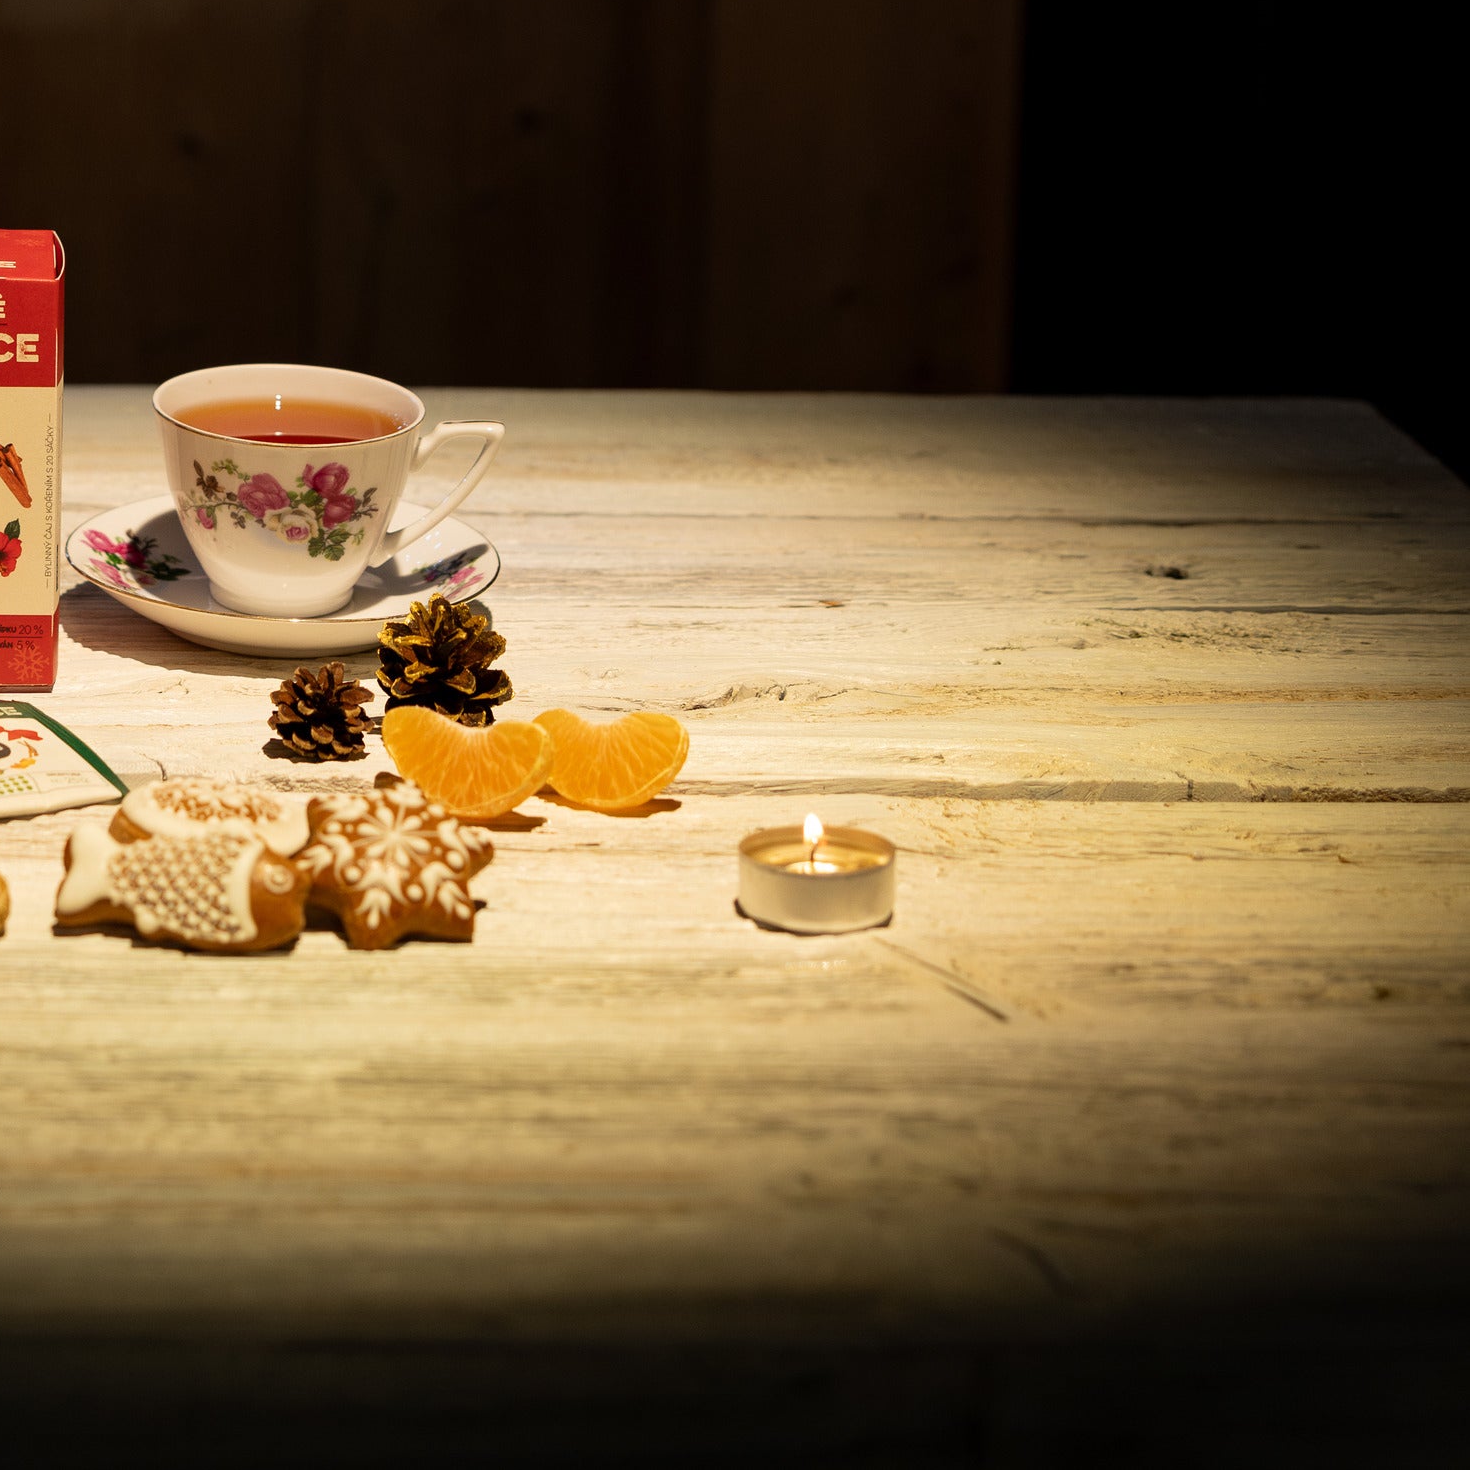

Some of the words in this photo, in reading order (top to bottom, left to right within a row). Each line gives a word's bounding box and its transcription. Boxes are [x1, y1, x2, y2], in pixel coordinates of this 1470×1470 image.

[45, 426, 54, 454] SÁČKY
[46, 456, 54, 466] 20
[44, 476, 53, 514] KOŘENÍM
[44, 523, 52, 540] ČAJ
[44, 540, 52, 577] BYLINNÝ
[18, 625, 32, 634] 20
[34, 625, 44, 634] %
[16, 640, 23, 650] 5
[25, 640, 36, 650] %
